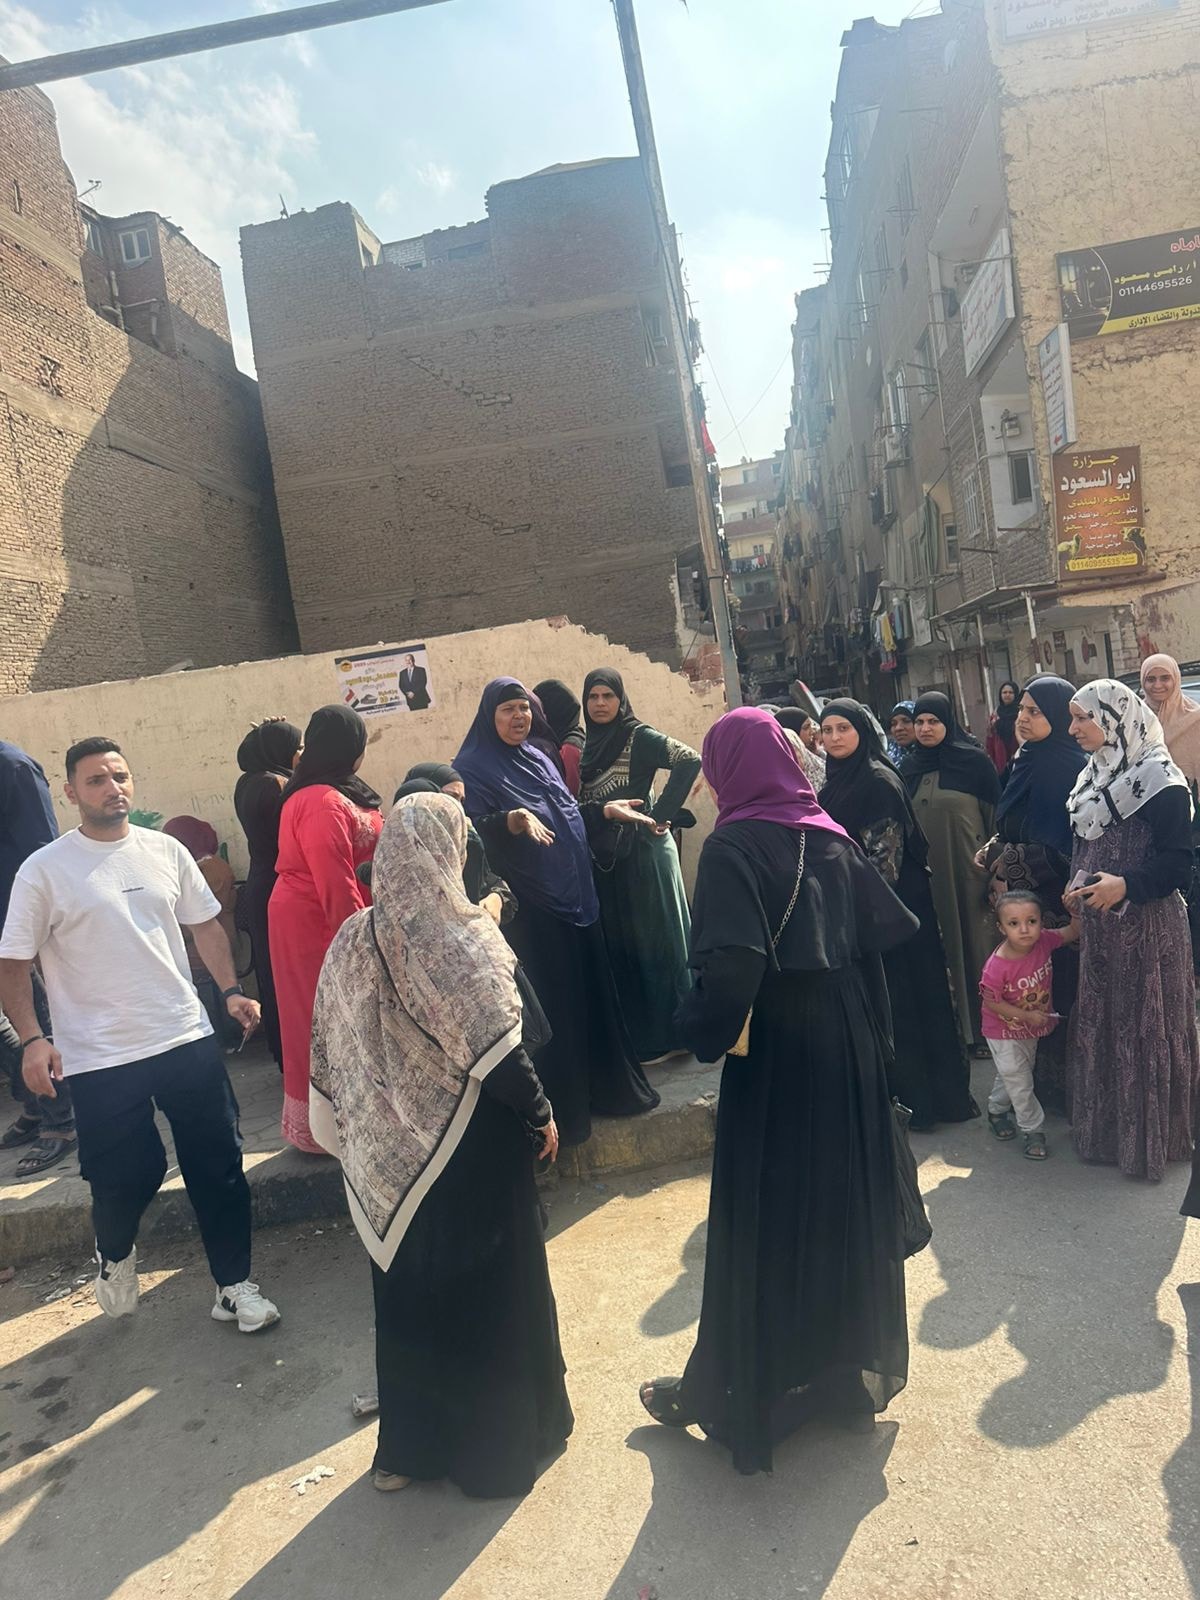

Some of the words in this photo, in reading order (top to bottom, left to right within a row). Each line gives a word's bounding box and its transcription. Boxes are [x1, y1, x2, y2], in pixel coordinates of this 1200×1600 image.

[1118, 275, 1193, 297] 01144695526
[1061, 468, 1112, 495] السعود
[1115, 464, 1136, 490] ابو
